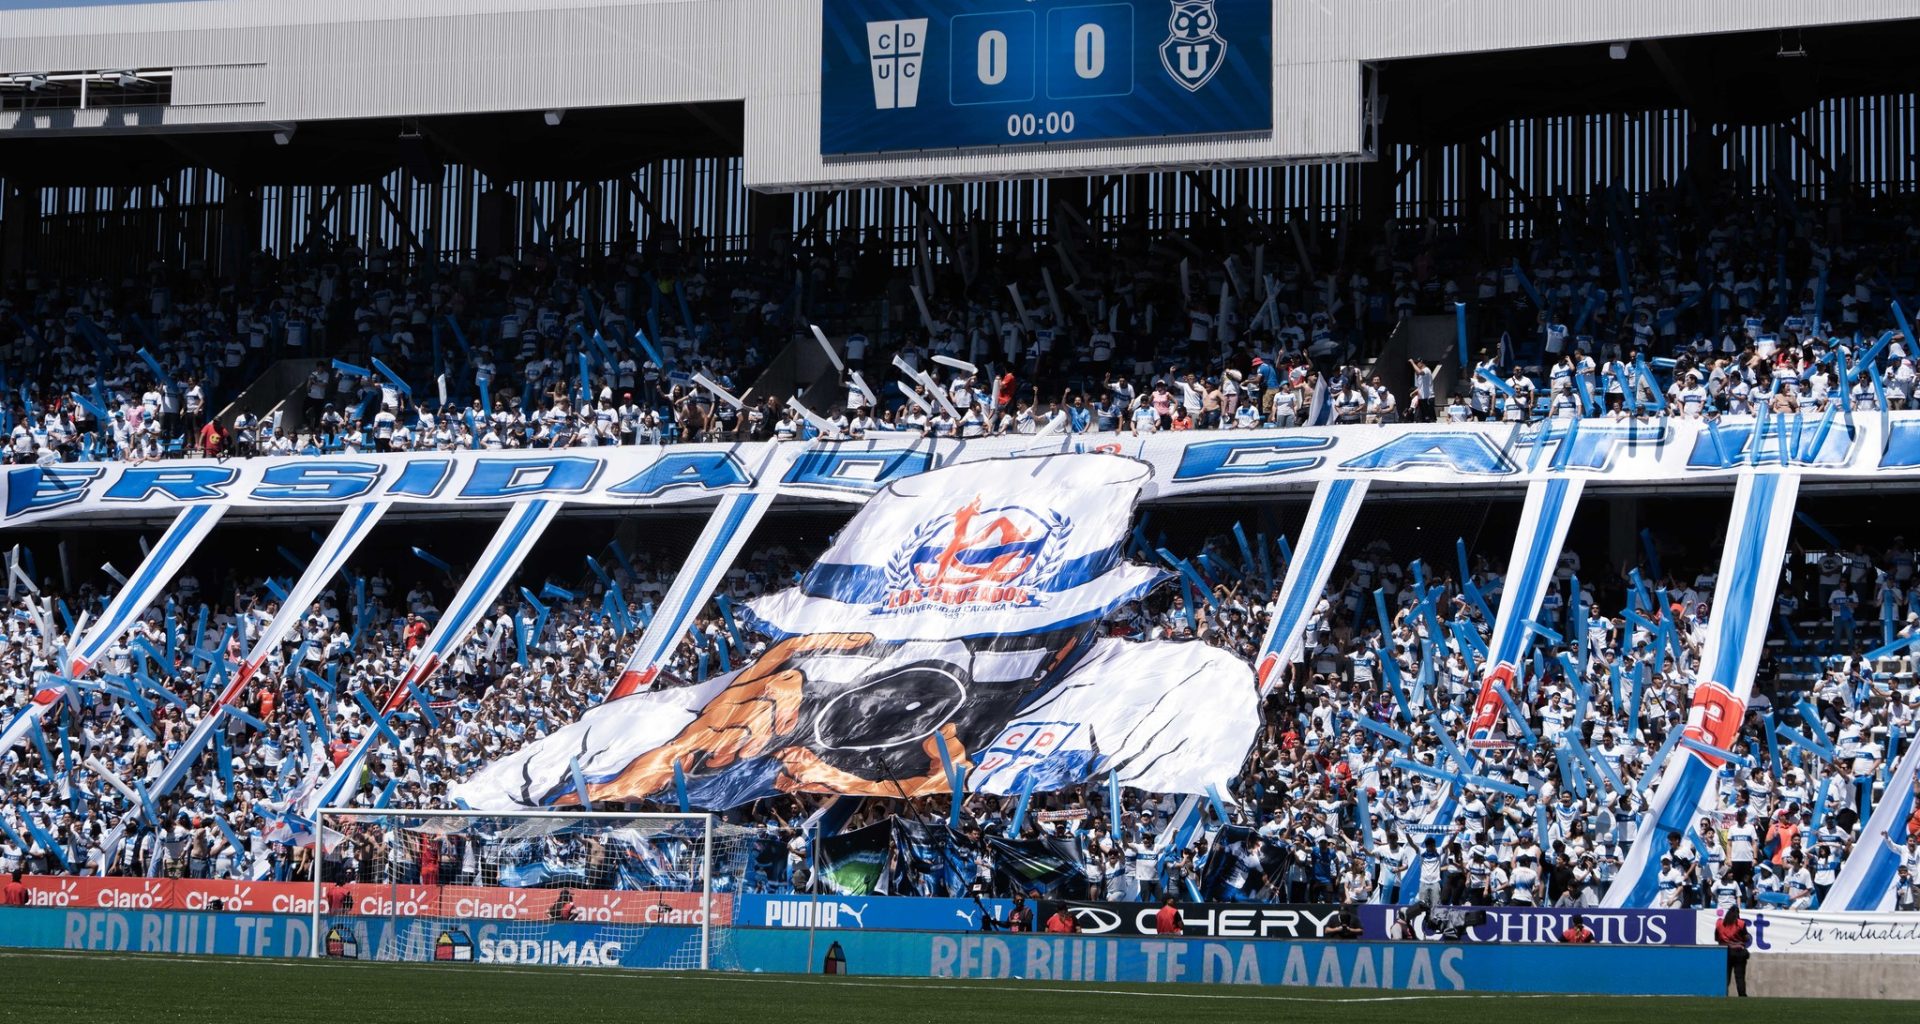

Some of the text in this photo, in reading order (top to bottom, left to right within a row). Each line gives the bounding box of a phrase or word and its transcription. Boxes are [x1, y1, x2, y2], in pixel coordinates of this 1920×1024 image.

[878, 33, 916, 50] C D
[977, 23, 1105, 85] 0 0
[878, 62, 916, 80] U C
[1177, 44, 1209, 79] U
[1007, 111, 1075, 137] 00:00
[888, 585, 1028, 609] LOS CRUZADOS
[98, 888, 153, 908] Claro
[361, 896, 418, 916] Claro
[456, 898, 517, 919] Claro
[765, 900, 838, 928] PUMA
[1135, 908, 1340, 938] CHERY
[1789, 917, 1825, 945] tu
[479, 939, 622, 966] SODIMAC
[1202, 943, 1262, 986] DA
